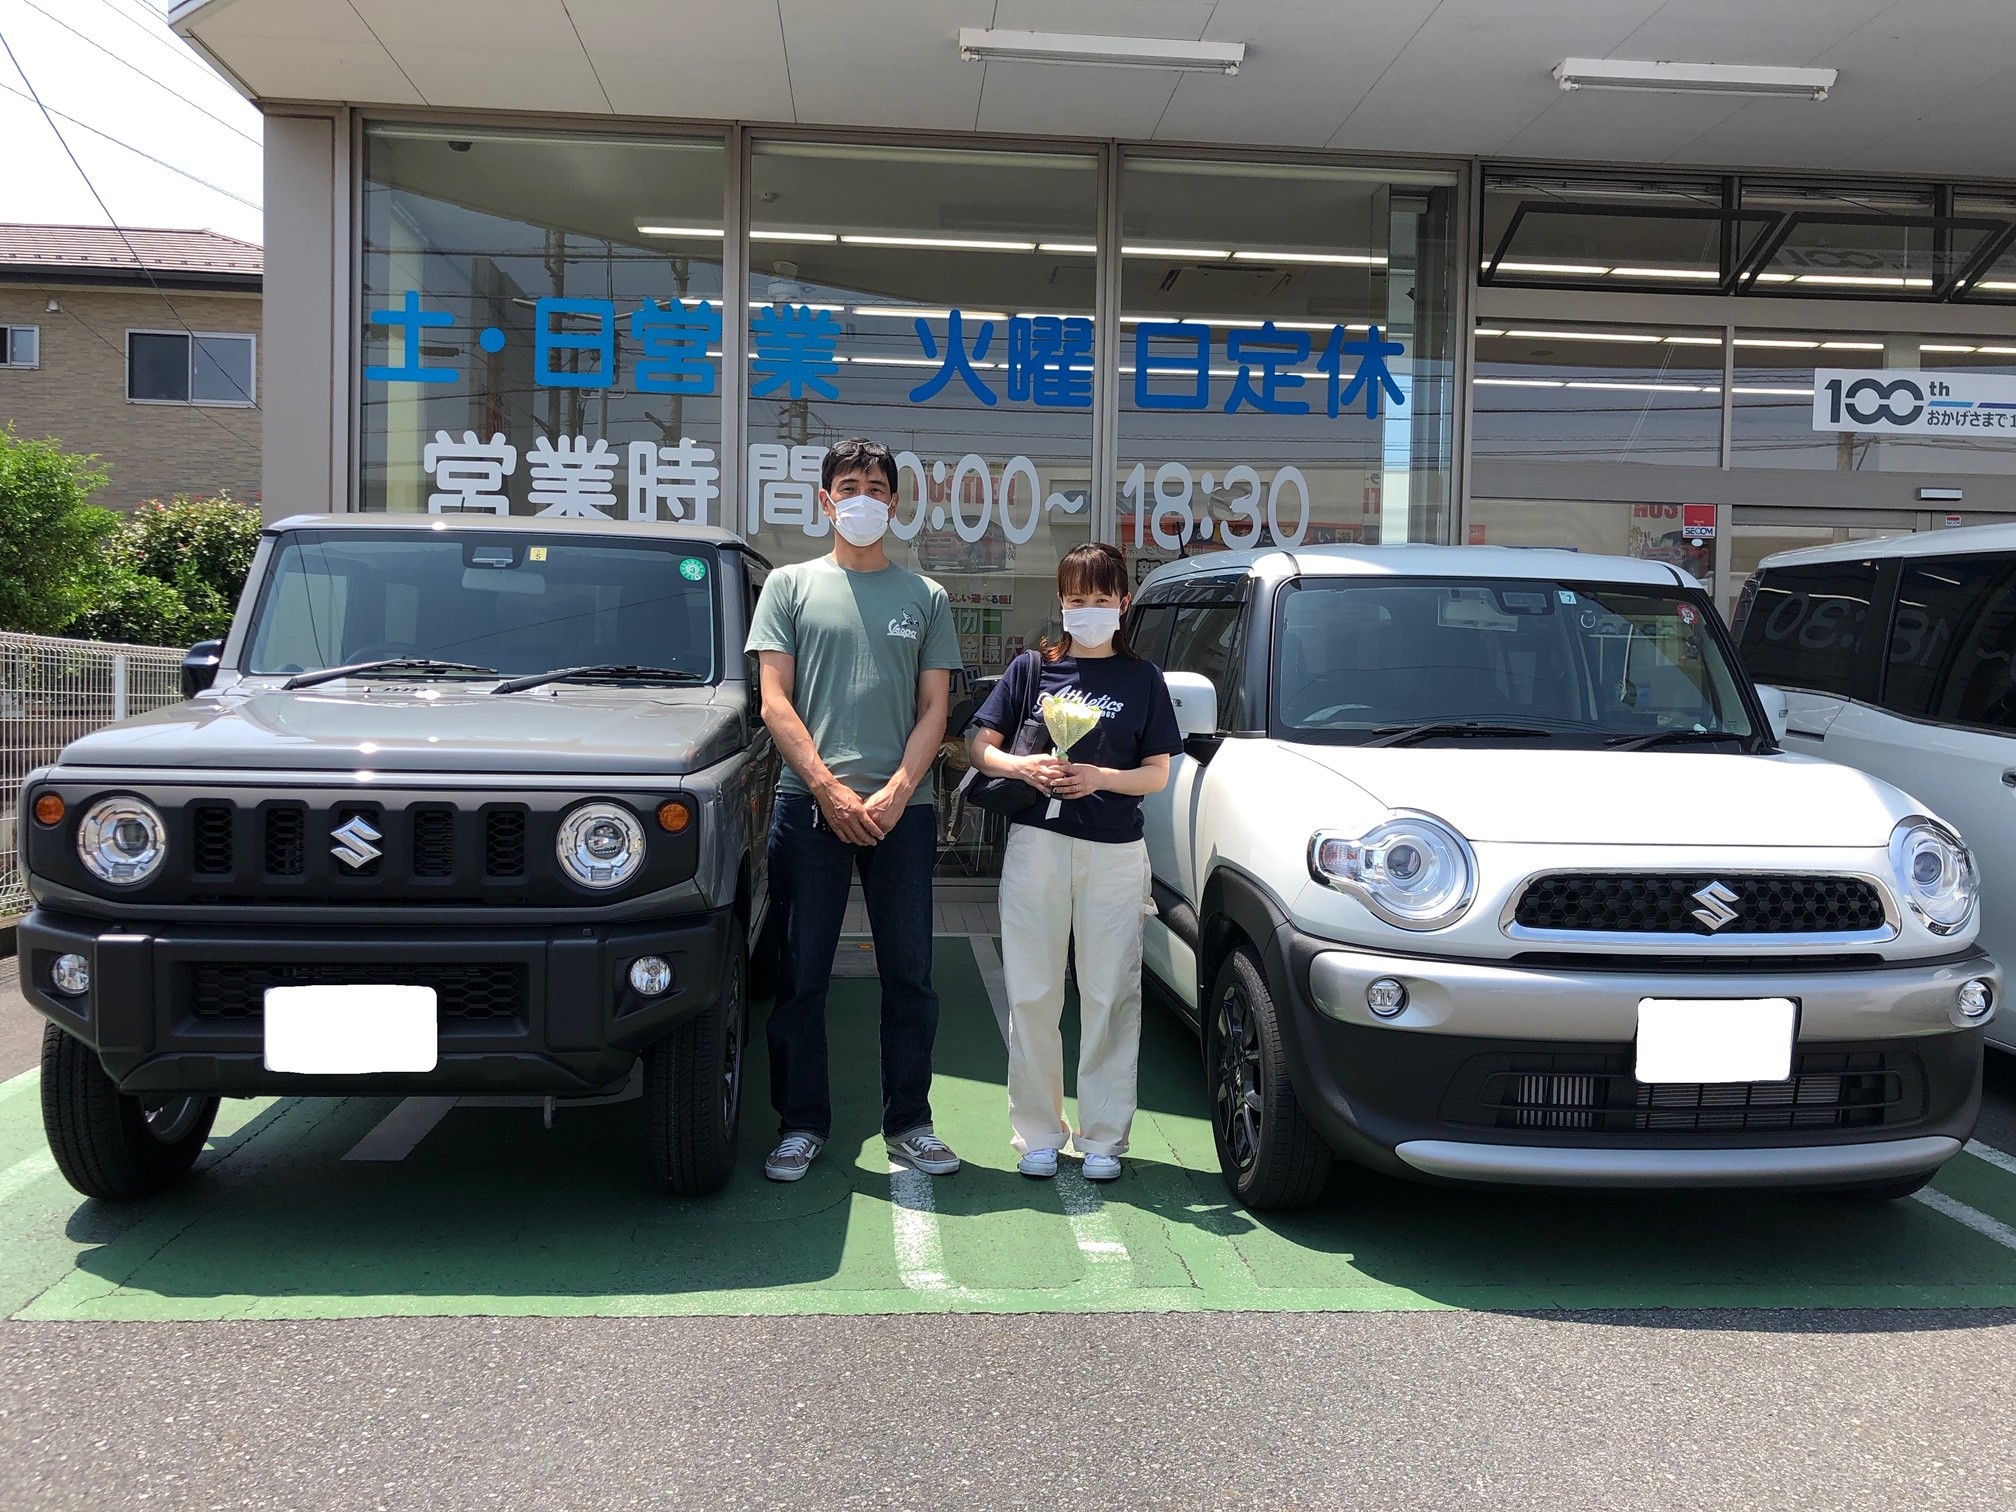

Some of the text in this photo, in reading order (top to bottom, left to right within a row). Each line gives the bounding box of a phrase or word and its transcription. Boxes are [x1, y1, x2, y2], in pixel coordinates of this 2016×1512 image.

[365, 290, 1406, 419] 土・日営業 火曜日定休
[424, 429, 831, 538] 営業時間
[1122, 462, 1310, 550] 18:30
[1685, 527, 1713, 535] SECOM
[887, 618, 917, 640] Vespa
[1032, 684, 1124, 713] Athletics
